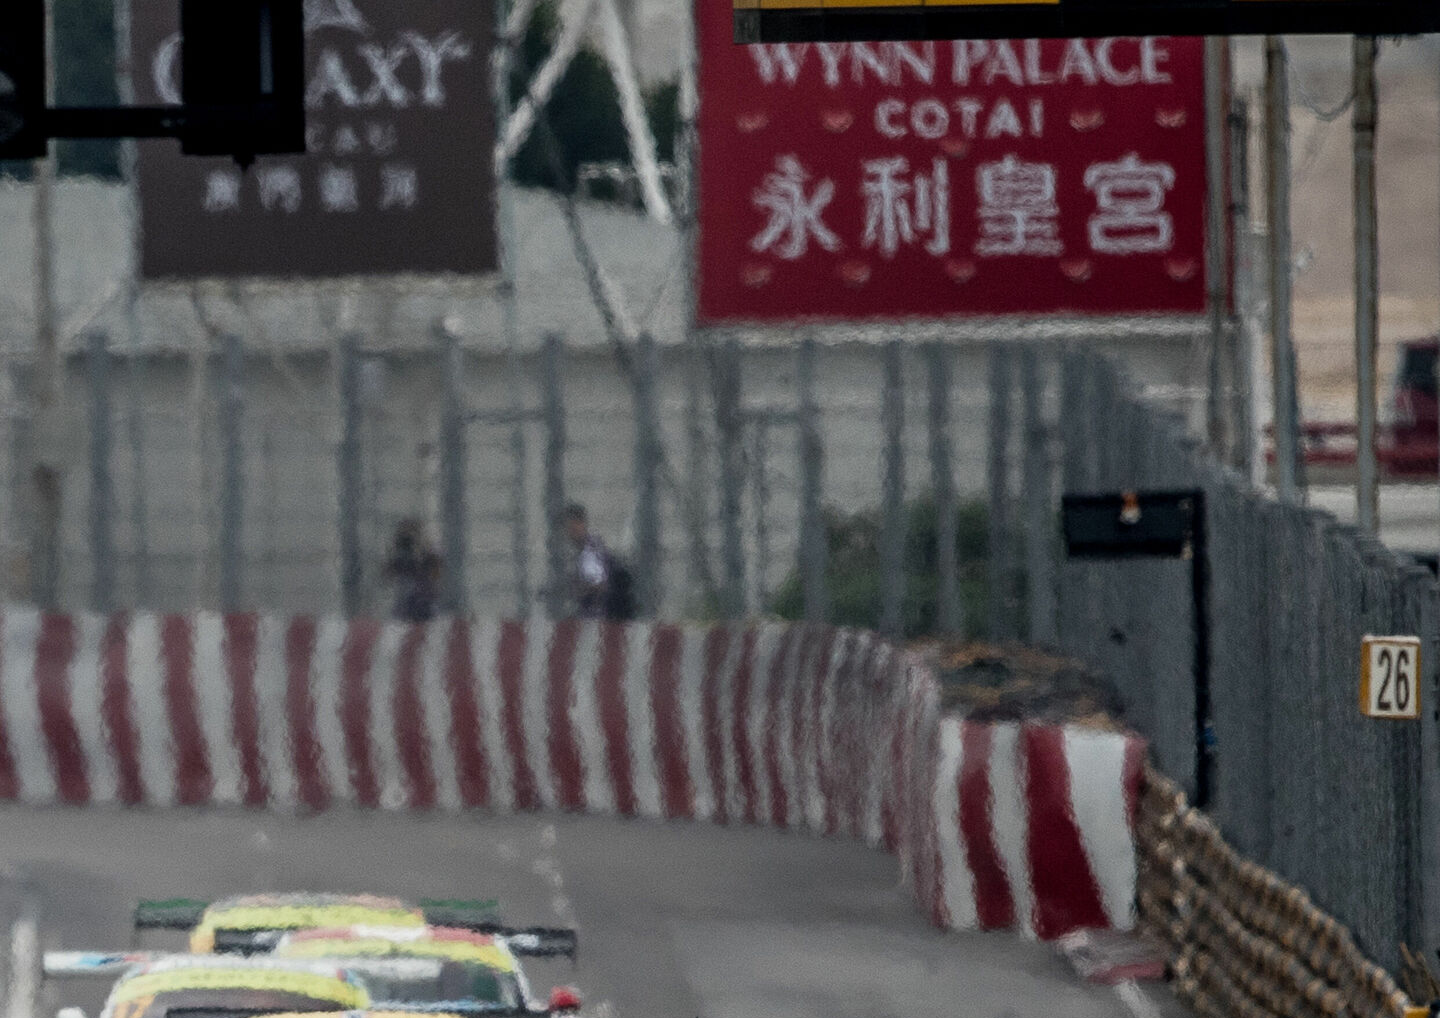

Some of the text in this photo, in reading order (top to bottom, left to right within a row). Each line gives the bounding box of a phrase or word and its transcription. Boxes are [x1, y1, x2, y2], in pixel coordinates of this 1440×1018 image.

[748, 36, 1172, 86] WYNN PALACE
[874, 98, 1045, 138] COTAI
[750, 152, 1176, 259] 永利皇宮
[1377, 647, 1410, 712] 26
